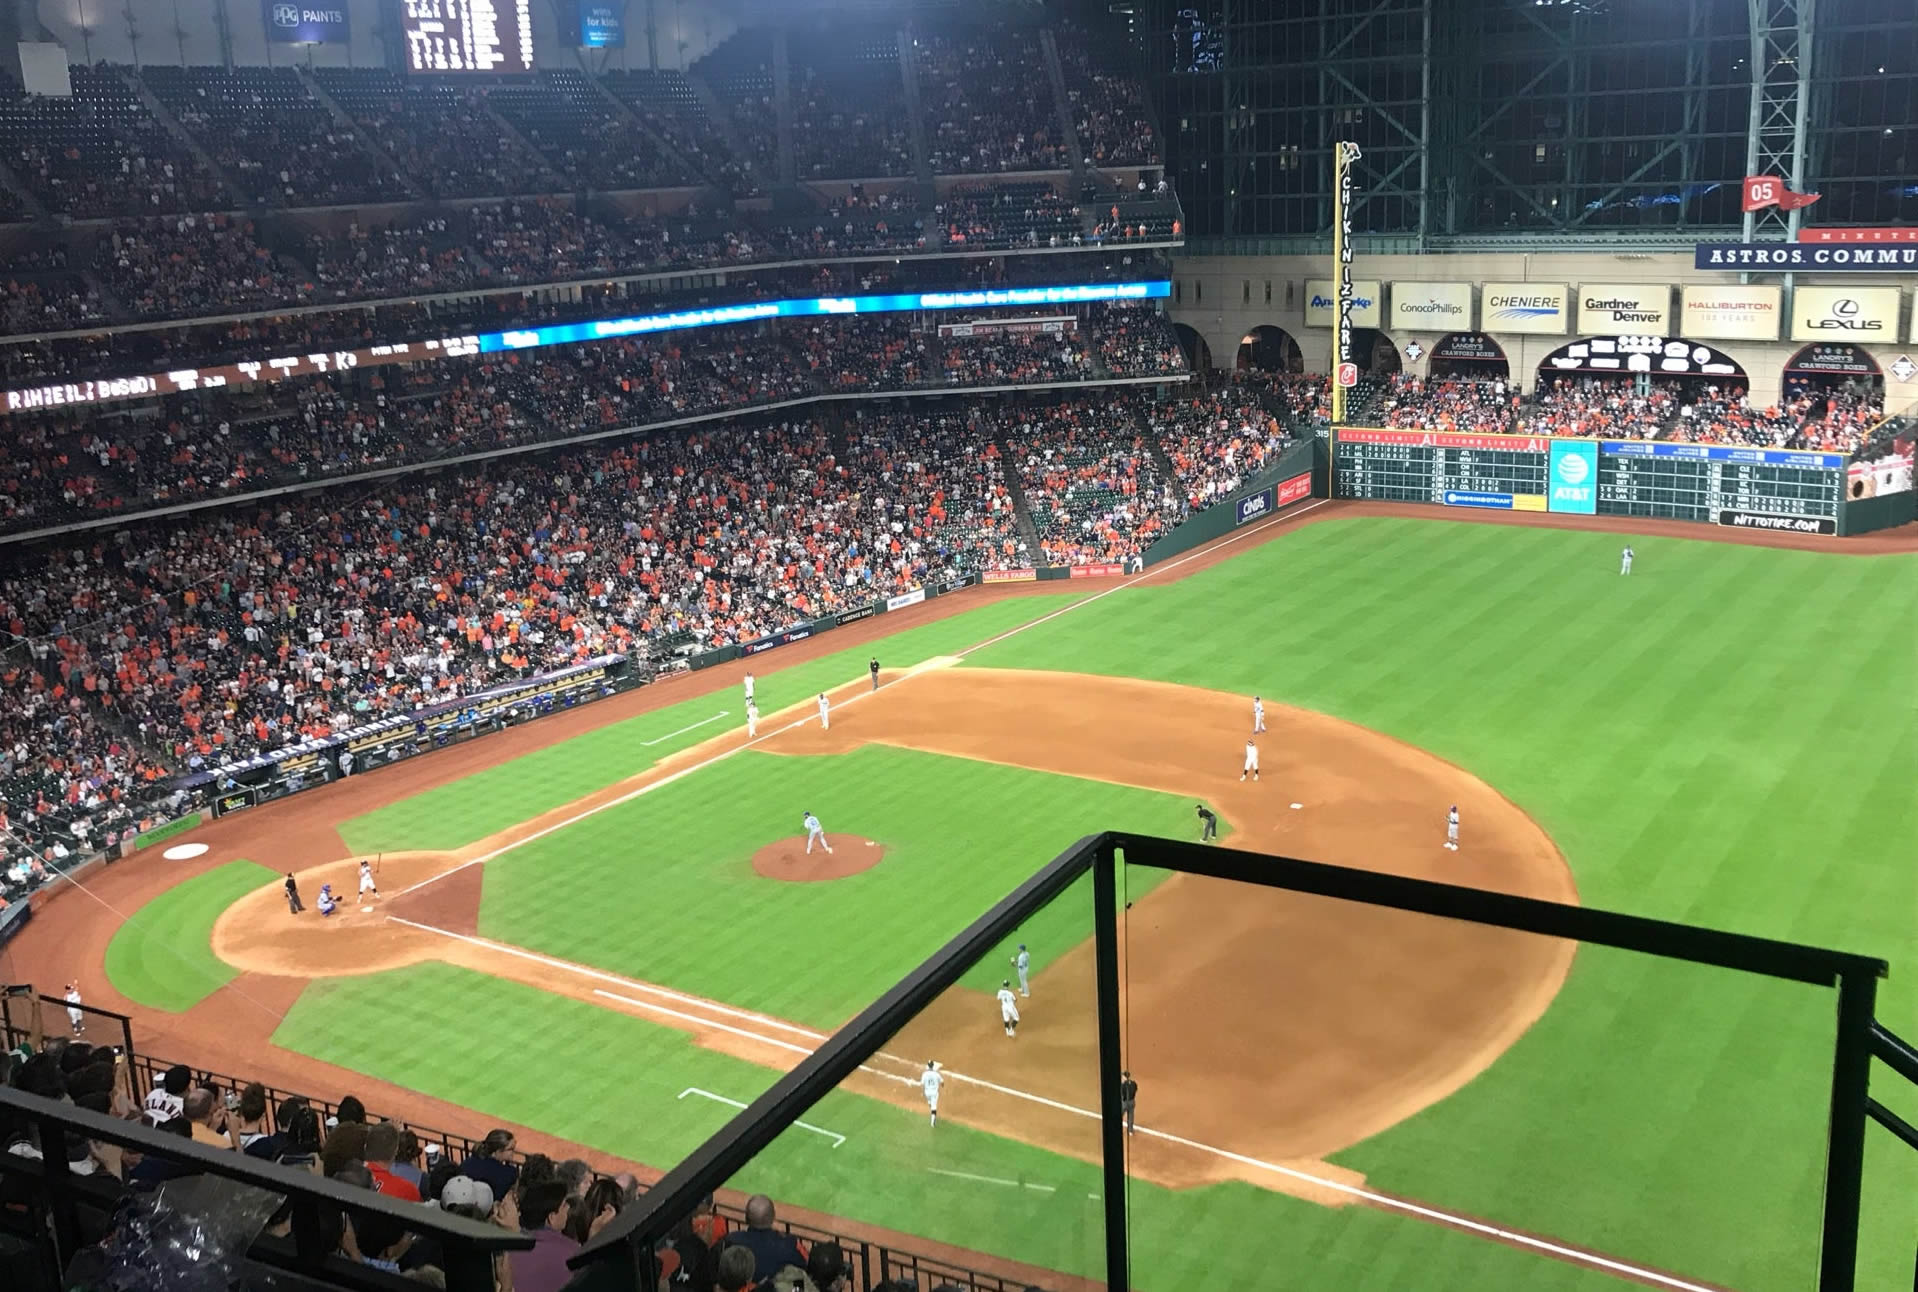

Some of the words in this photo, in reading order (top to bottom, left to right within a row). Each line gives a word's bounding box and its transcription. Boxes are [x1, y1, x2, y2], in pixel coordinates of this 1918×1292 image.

[274, 6, 297, 24] PPG
[303, 10, 342, 23] PAINTS
[587, 16, 599, 26] for
[601, 16, 618, 27] kids
[1751, 182, 1773, 201] 05
[1342, 176, 1351, 262] CHIKIN
[1710, 250, 1802, 264] ASTROS
[1814, 249, 1917, 264] COMMU
[1341, 266, 1351, 296] IZ
[1490, 296, 1560, 308] CHENIERE
[1585, 298, 1639, 310] Gardner
[1688, 302, 1773, 310] HALLIBURTON
[1400, 303, 1463, 315] ConocoPhillips
[1613, 311, 1662, 323] Denver
[1722, 314, 1755, 322] YEARS
[1341, 300, 1351, 361] FARE
[1806, 319, 1883, 330] LEXUS
[8, 391, 22, 409] R
[31, 390, 43, 407] H
[53, 387, 65, 404] E
[1315, 429, 1329, 438] 315
[1554, 487, 1591, 500] AT&T
[1734, 514, 1820, 532] NITTOTIRE.COM
[984, 572, 1009, 580] WELLS
[1011, 571, 1036, 579] FARGO
[842, 612, 860, 622] CADENCE
[861, 609, 873, 618] BANK
[790, 631, 809, 641] Fanatics
[754, 642, 774, 652] Fanatics
